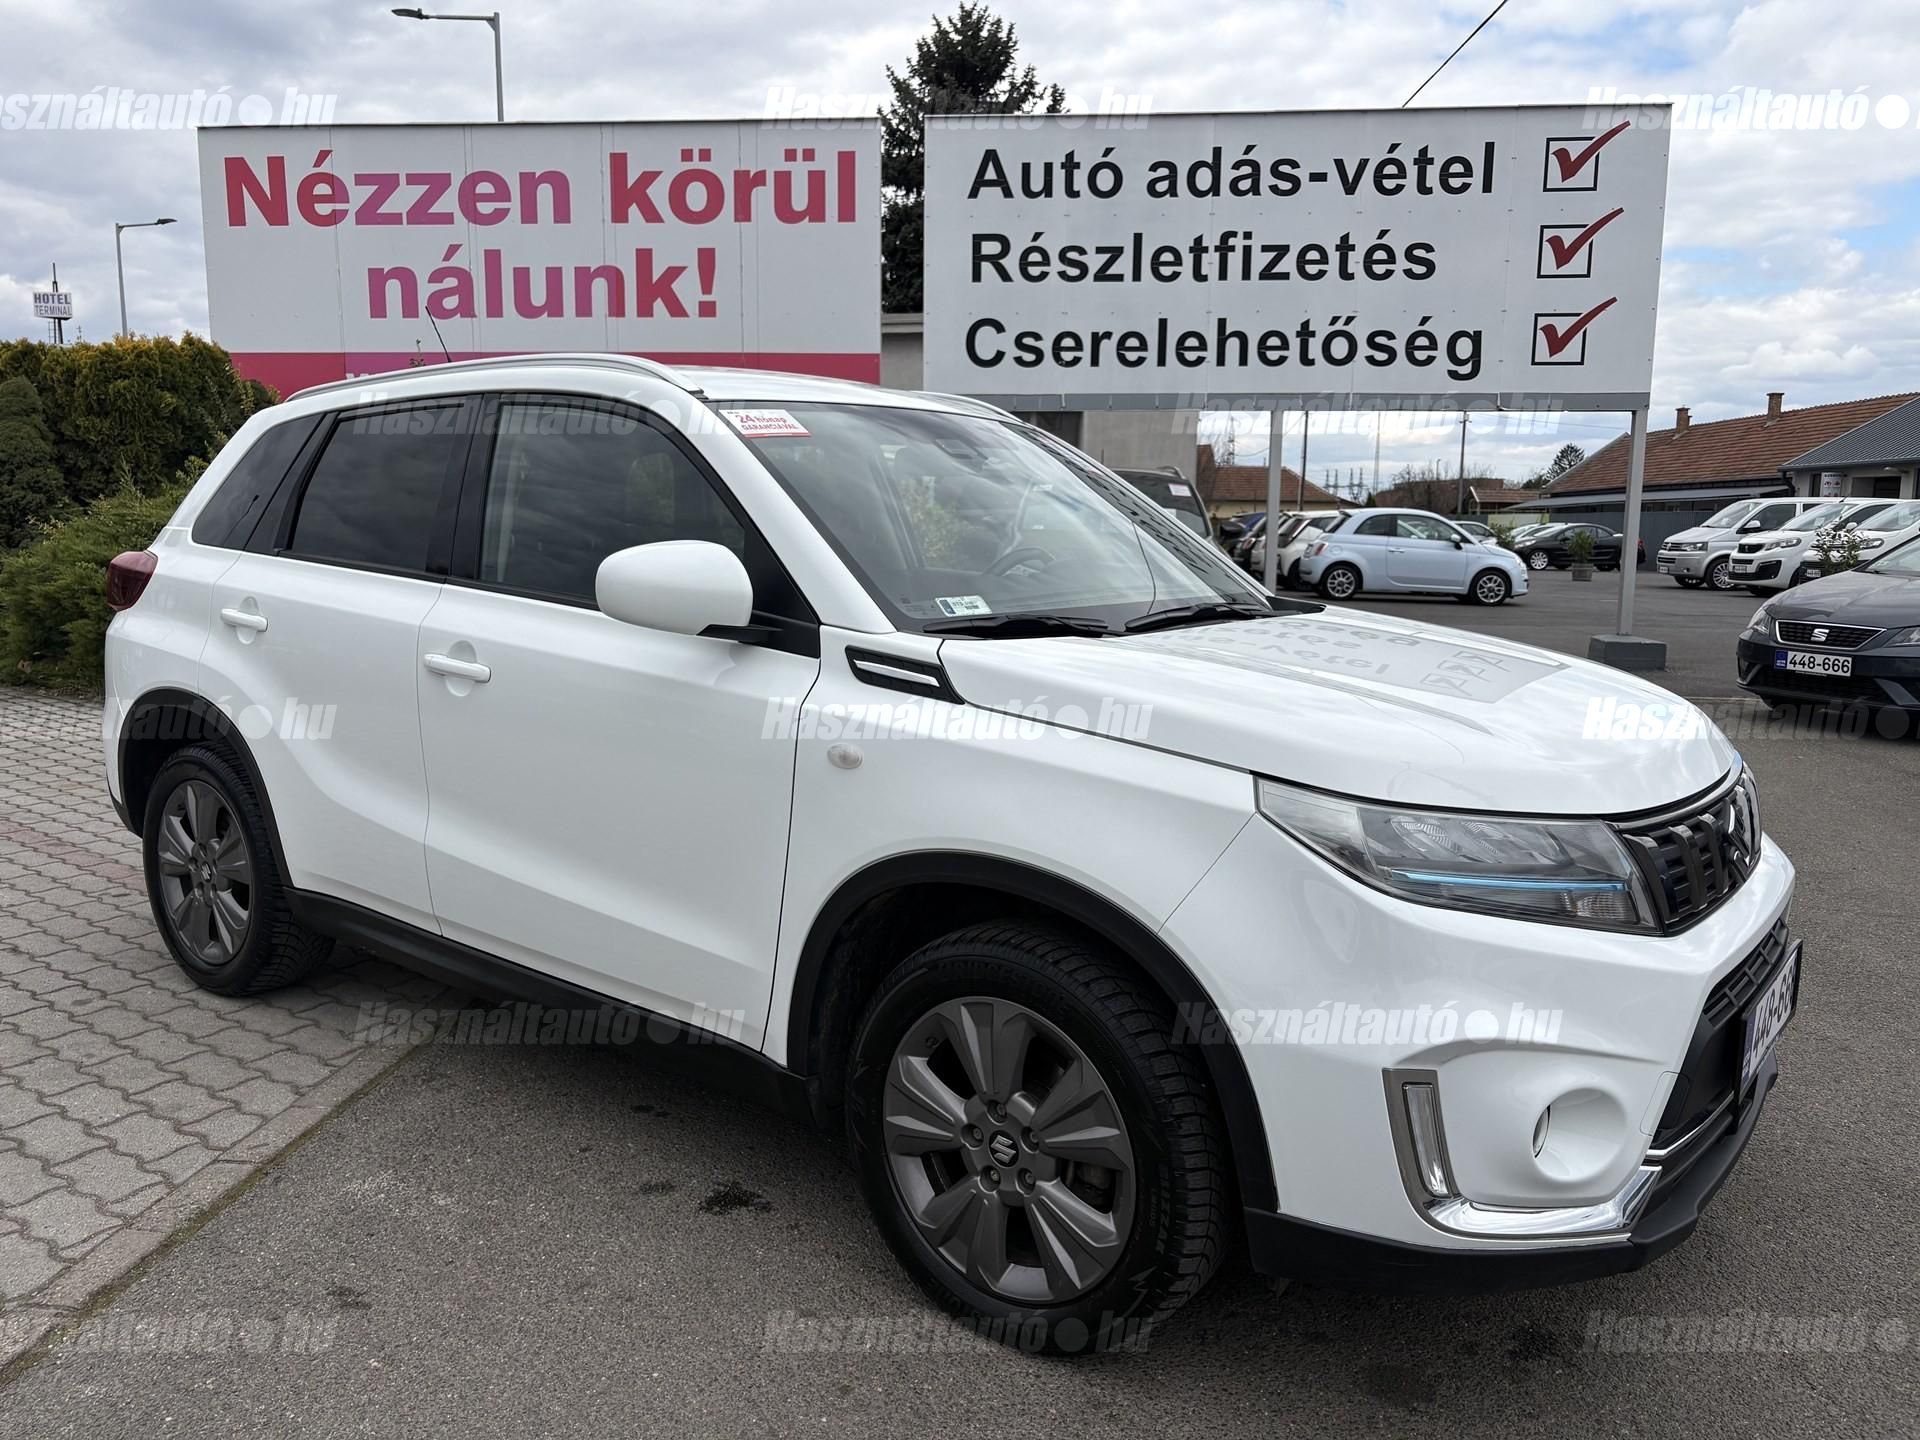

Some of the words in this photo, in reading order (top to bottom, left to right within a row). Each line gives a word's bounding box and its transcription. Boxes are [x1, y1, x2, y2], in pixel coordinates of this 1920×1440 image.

[224, 149, 571, 227] Nézzen
[609, 148, 856, 225] körül
[968, 147, 1123, 199] Autó
[1146, 142, 1495, 198] adás-vétel
[367, 243, 716, 320] nálunk!
[971, 229, 1437, 284] Részletfizetés
[34, 293, 71, 305] HOTEL
[34, 304, 73, 316] TERMINAL
[965, 316, 1482, 381] Cserelehetőség
[735, 414, 756, 424] 24
[753, 415, 788, 424] hónap
[1788, 654, 1851, 674] 448-666
